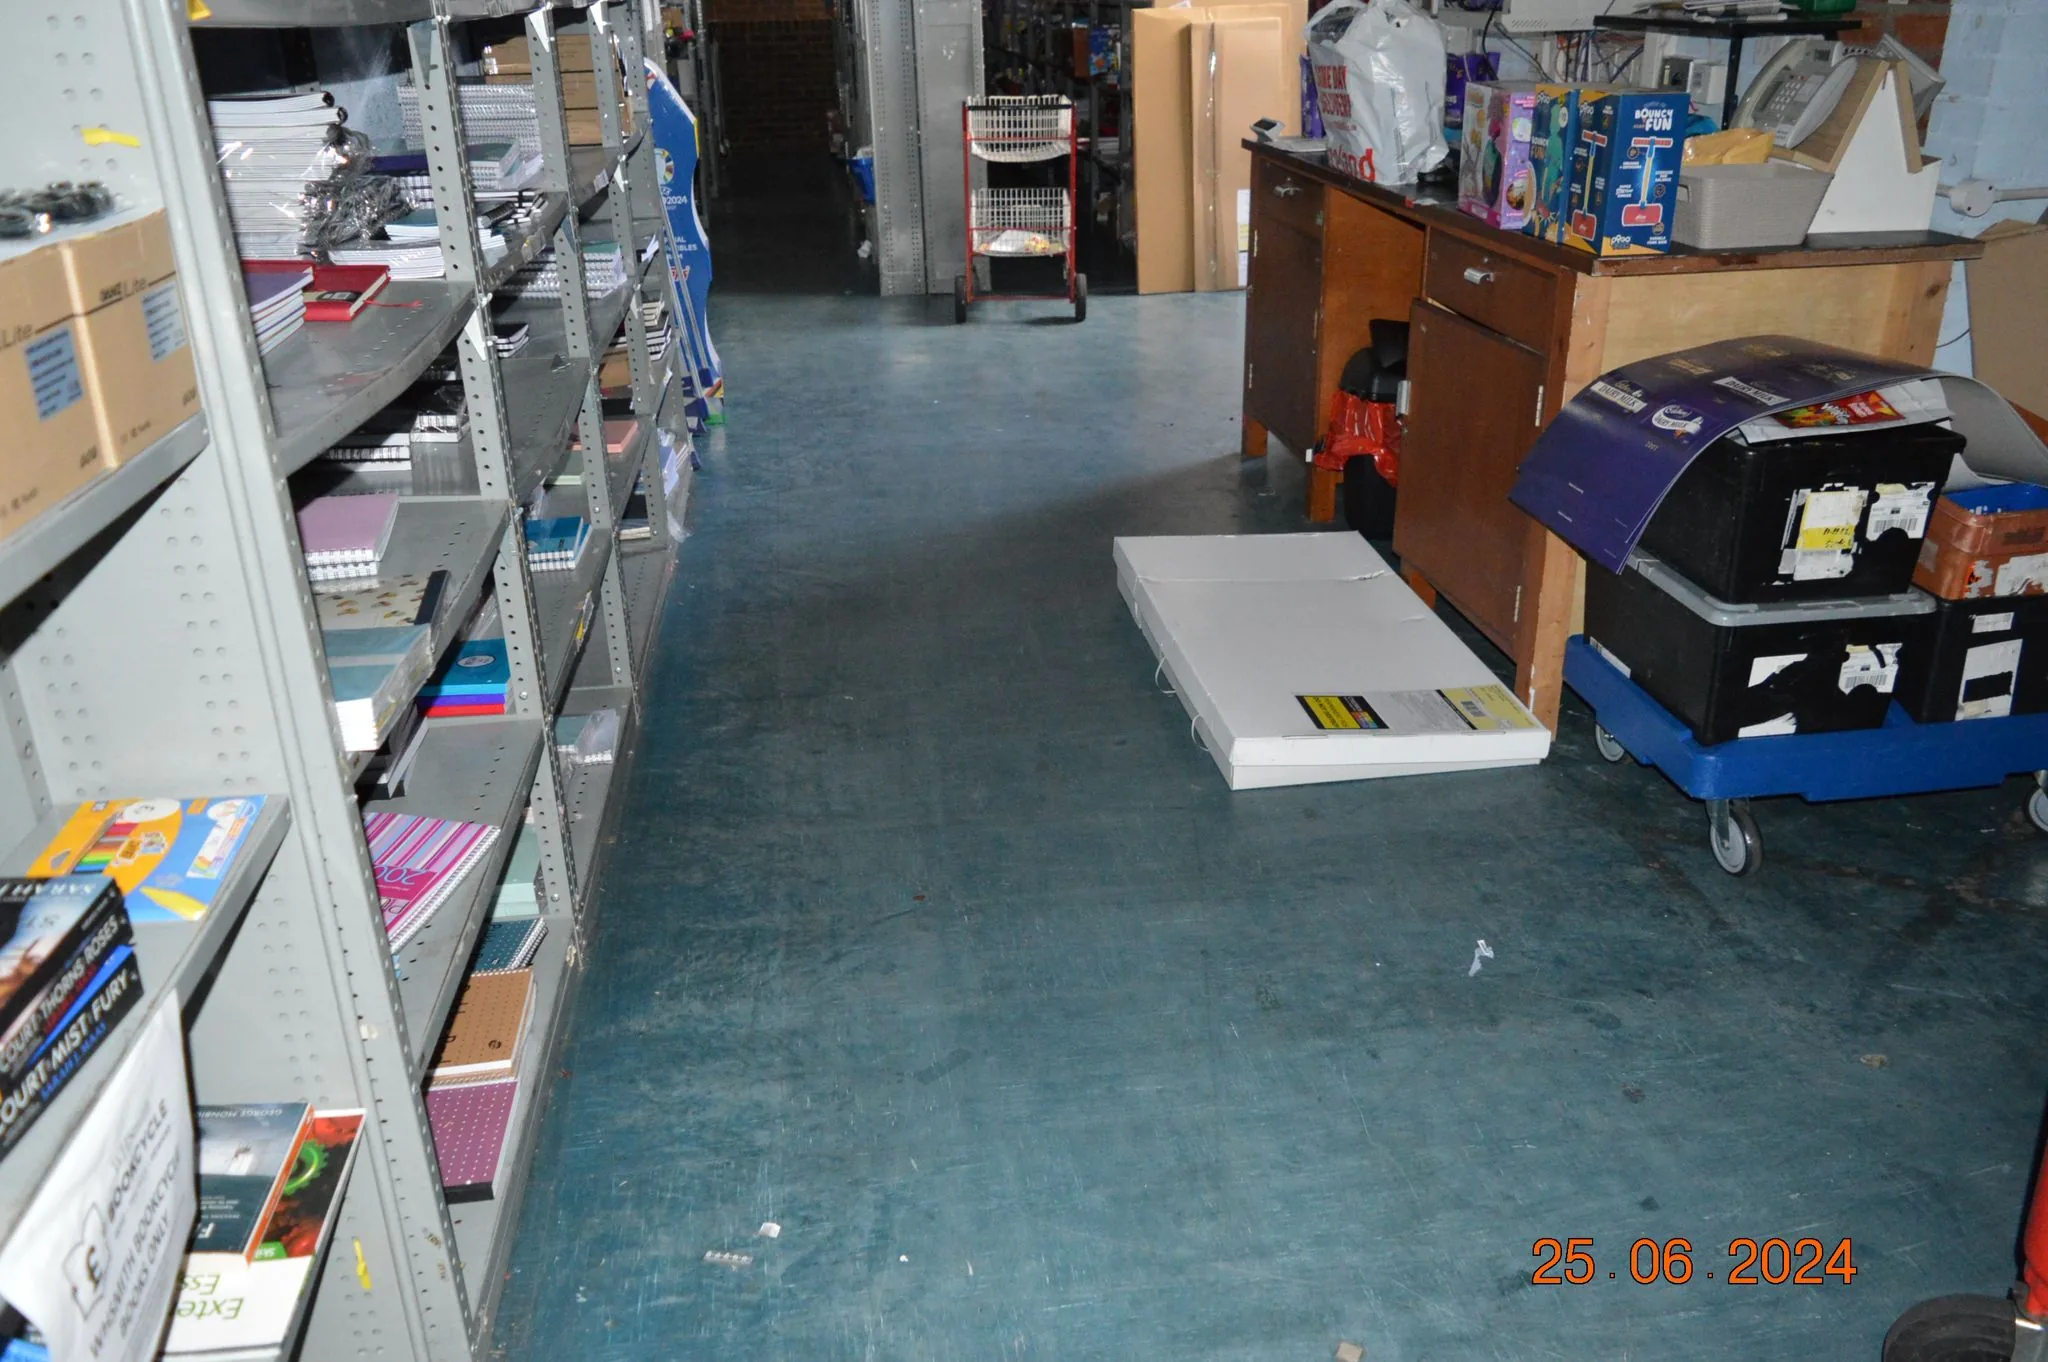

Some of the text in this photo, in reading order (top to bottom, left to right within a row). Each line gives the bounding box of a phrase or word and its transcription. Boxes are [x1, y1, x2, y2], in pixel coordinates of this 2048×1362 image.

[1634, 108, 1674, 119] BOUNCY
[1645, 119, 1672, 132] FUN
[1598, 382, 1640, 409] DAIRY MILK
[40, 957, 86, 1019] THORNS
[83, 914, 119, 961] ROSES
[50, 1012, 90, 1070] MIST
[91, 967, 130, 1020] FURY
[108, 1098, 168, 1223] BOOKCYCLE
[148, 1209, 170, 1266] ONLY
